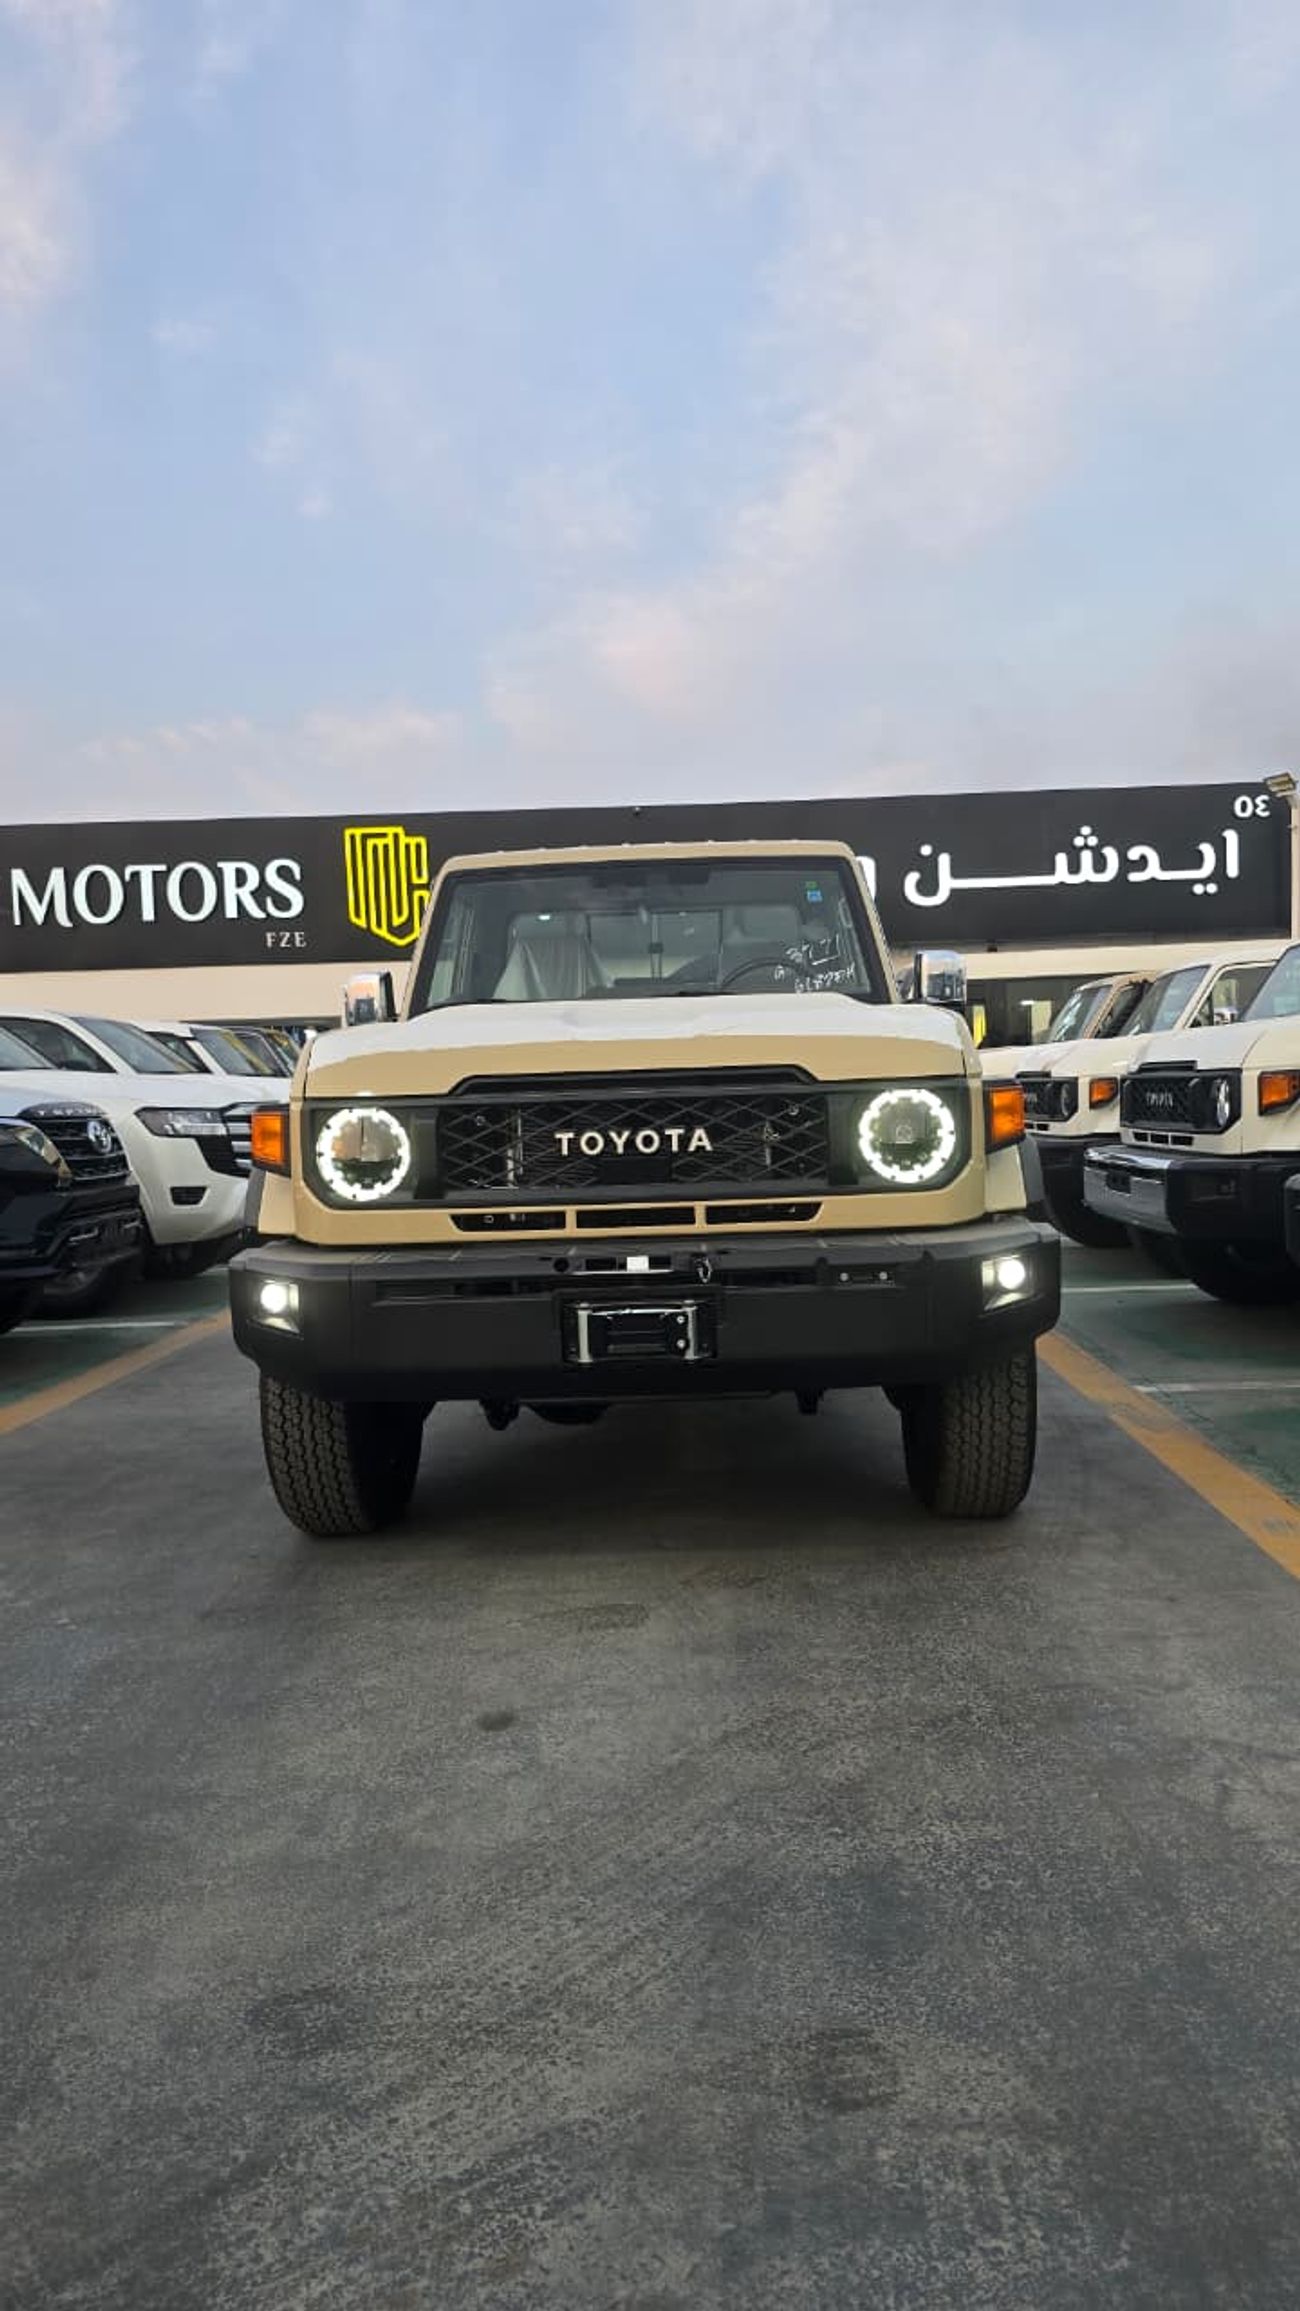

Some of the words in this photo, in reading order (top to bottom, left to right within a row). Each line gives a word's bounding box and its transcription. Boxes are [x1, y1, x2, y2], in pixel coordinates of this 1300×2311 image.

[902, 825, 1240, 908] ايدشن
[10, 858, 305, 928] MOTORS
[265, 931, 308, 949] FZE
[554, 1127, 713, 1157] TOYOTA
